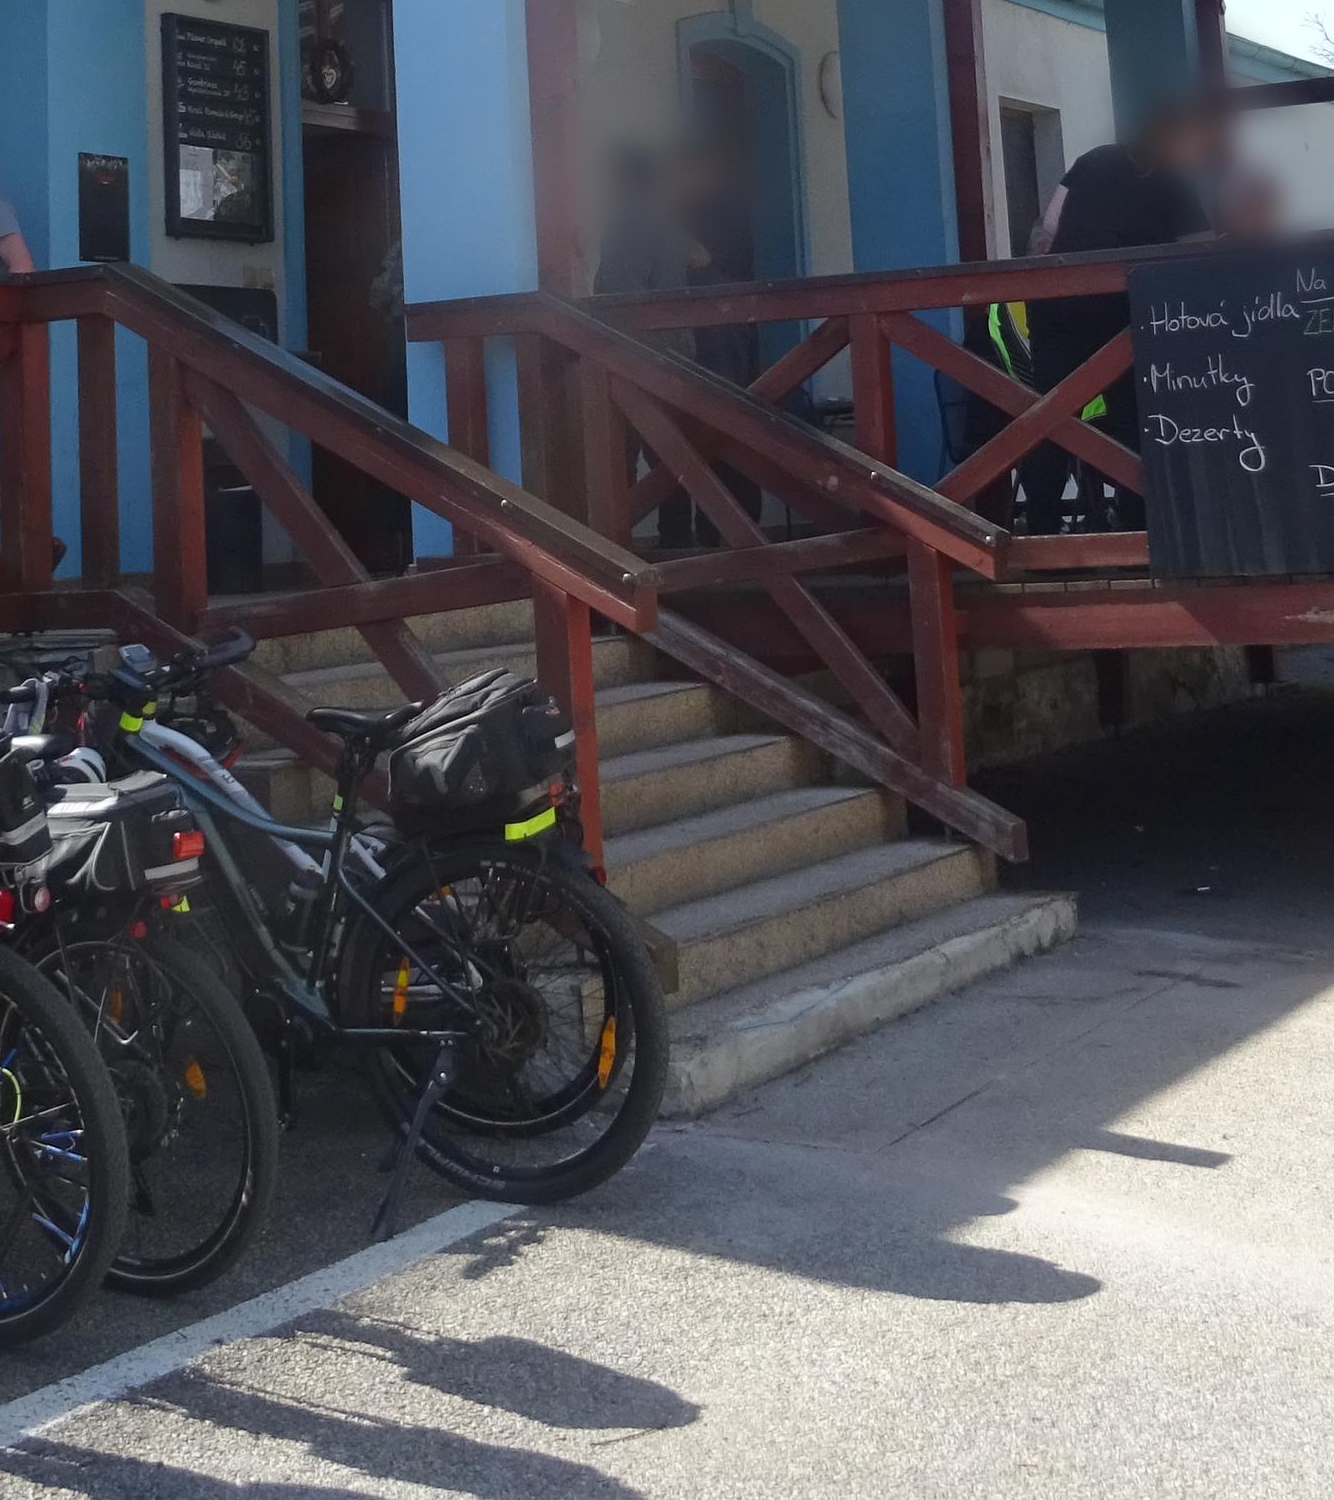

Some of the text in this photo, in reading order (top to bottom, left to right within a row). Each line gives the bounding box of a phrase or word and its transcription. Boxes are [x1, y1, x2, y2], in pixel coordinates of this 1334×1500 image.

[1295, 267, 1327, 294] Na
[1150, 299, 1228, 333] Hotová
[1232, 293, 1300, 338] jídla
[1149, 354, 1256, 407] Minutky
[1147, 413, 1267, 472] Dezerty
